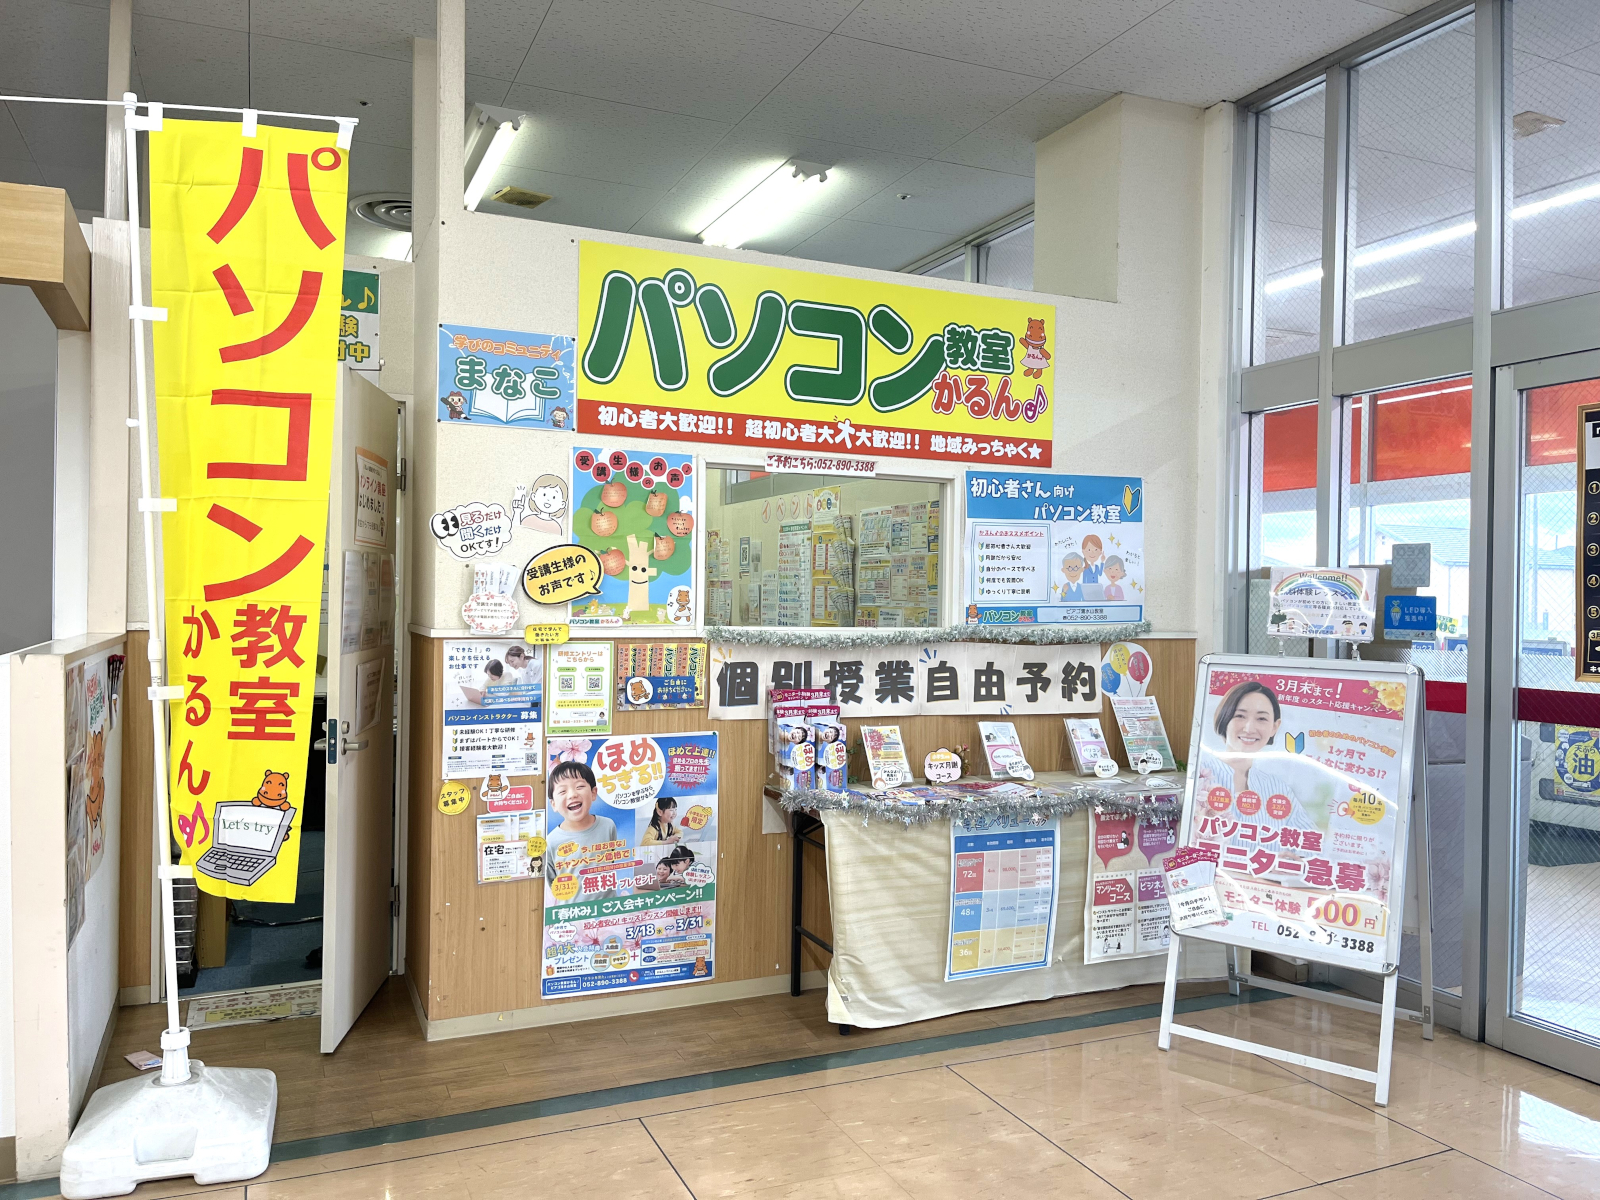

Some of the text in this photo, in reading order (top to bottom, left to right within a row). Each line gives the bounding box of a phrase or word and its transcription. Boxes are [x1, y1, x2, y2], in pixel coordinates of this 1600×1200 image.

[453, 334, 562, 360] 学びのコミュニティ
[582, 268, 946, 412] パソコン
[943, 322, 1014, 374] 教室
[454, 355, 561, 400] まなこ
[931, 372, 1021, 421] かるん
[598, 405, 734, 436] 初心者大歓迎!!
[460, 510, 502, 526] 見るだけ
[762, 497, 812, 520] イベント
[1033, 503, 1122, 524] パソコン教室
[460, 525, 502, 541] 聞くだけ
[526, 552, 587, 581] 受講生様の
[178, 604, 220, 796] かるん
[597, 737, 657, 773] ほめ
[1574, 745, 1596, 754] 天ぷら
[1573, 753, 1595, 777] 油
[441, 788, 465, 799] スタッフ
[443, 796, 465, 807] 募集中
[1361, 792, 1376, 805] 10
[221, 818, 274, 836] Let's try
[1199, 817, 1323, 852] パソコン教室
[484, 845, 504, 856] 在宅
[583, 873, 656, 894] 無料 プレゼント
[1096, 883, 1126, 894] マンツーマン
[1110, 892, 1131, 902] コース
[552, 905, 598, 920] 「春休み」
[626, 924, 655, 939] 3/18
[676, 915, 703, 931] 3/31
[1251, 920, 1269, 932] TEL
